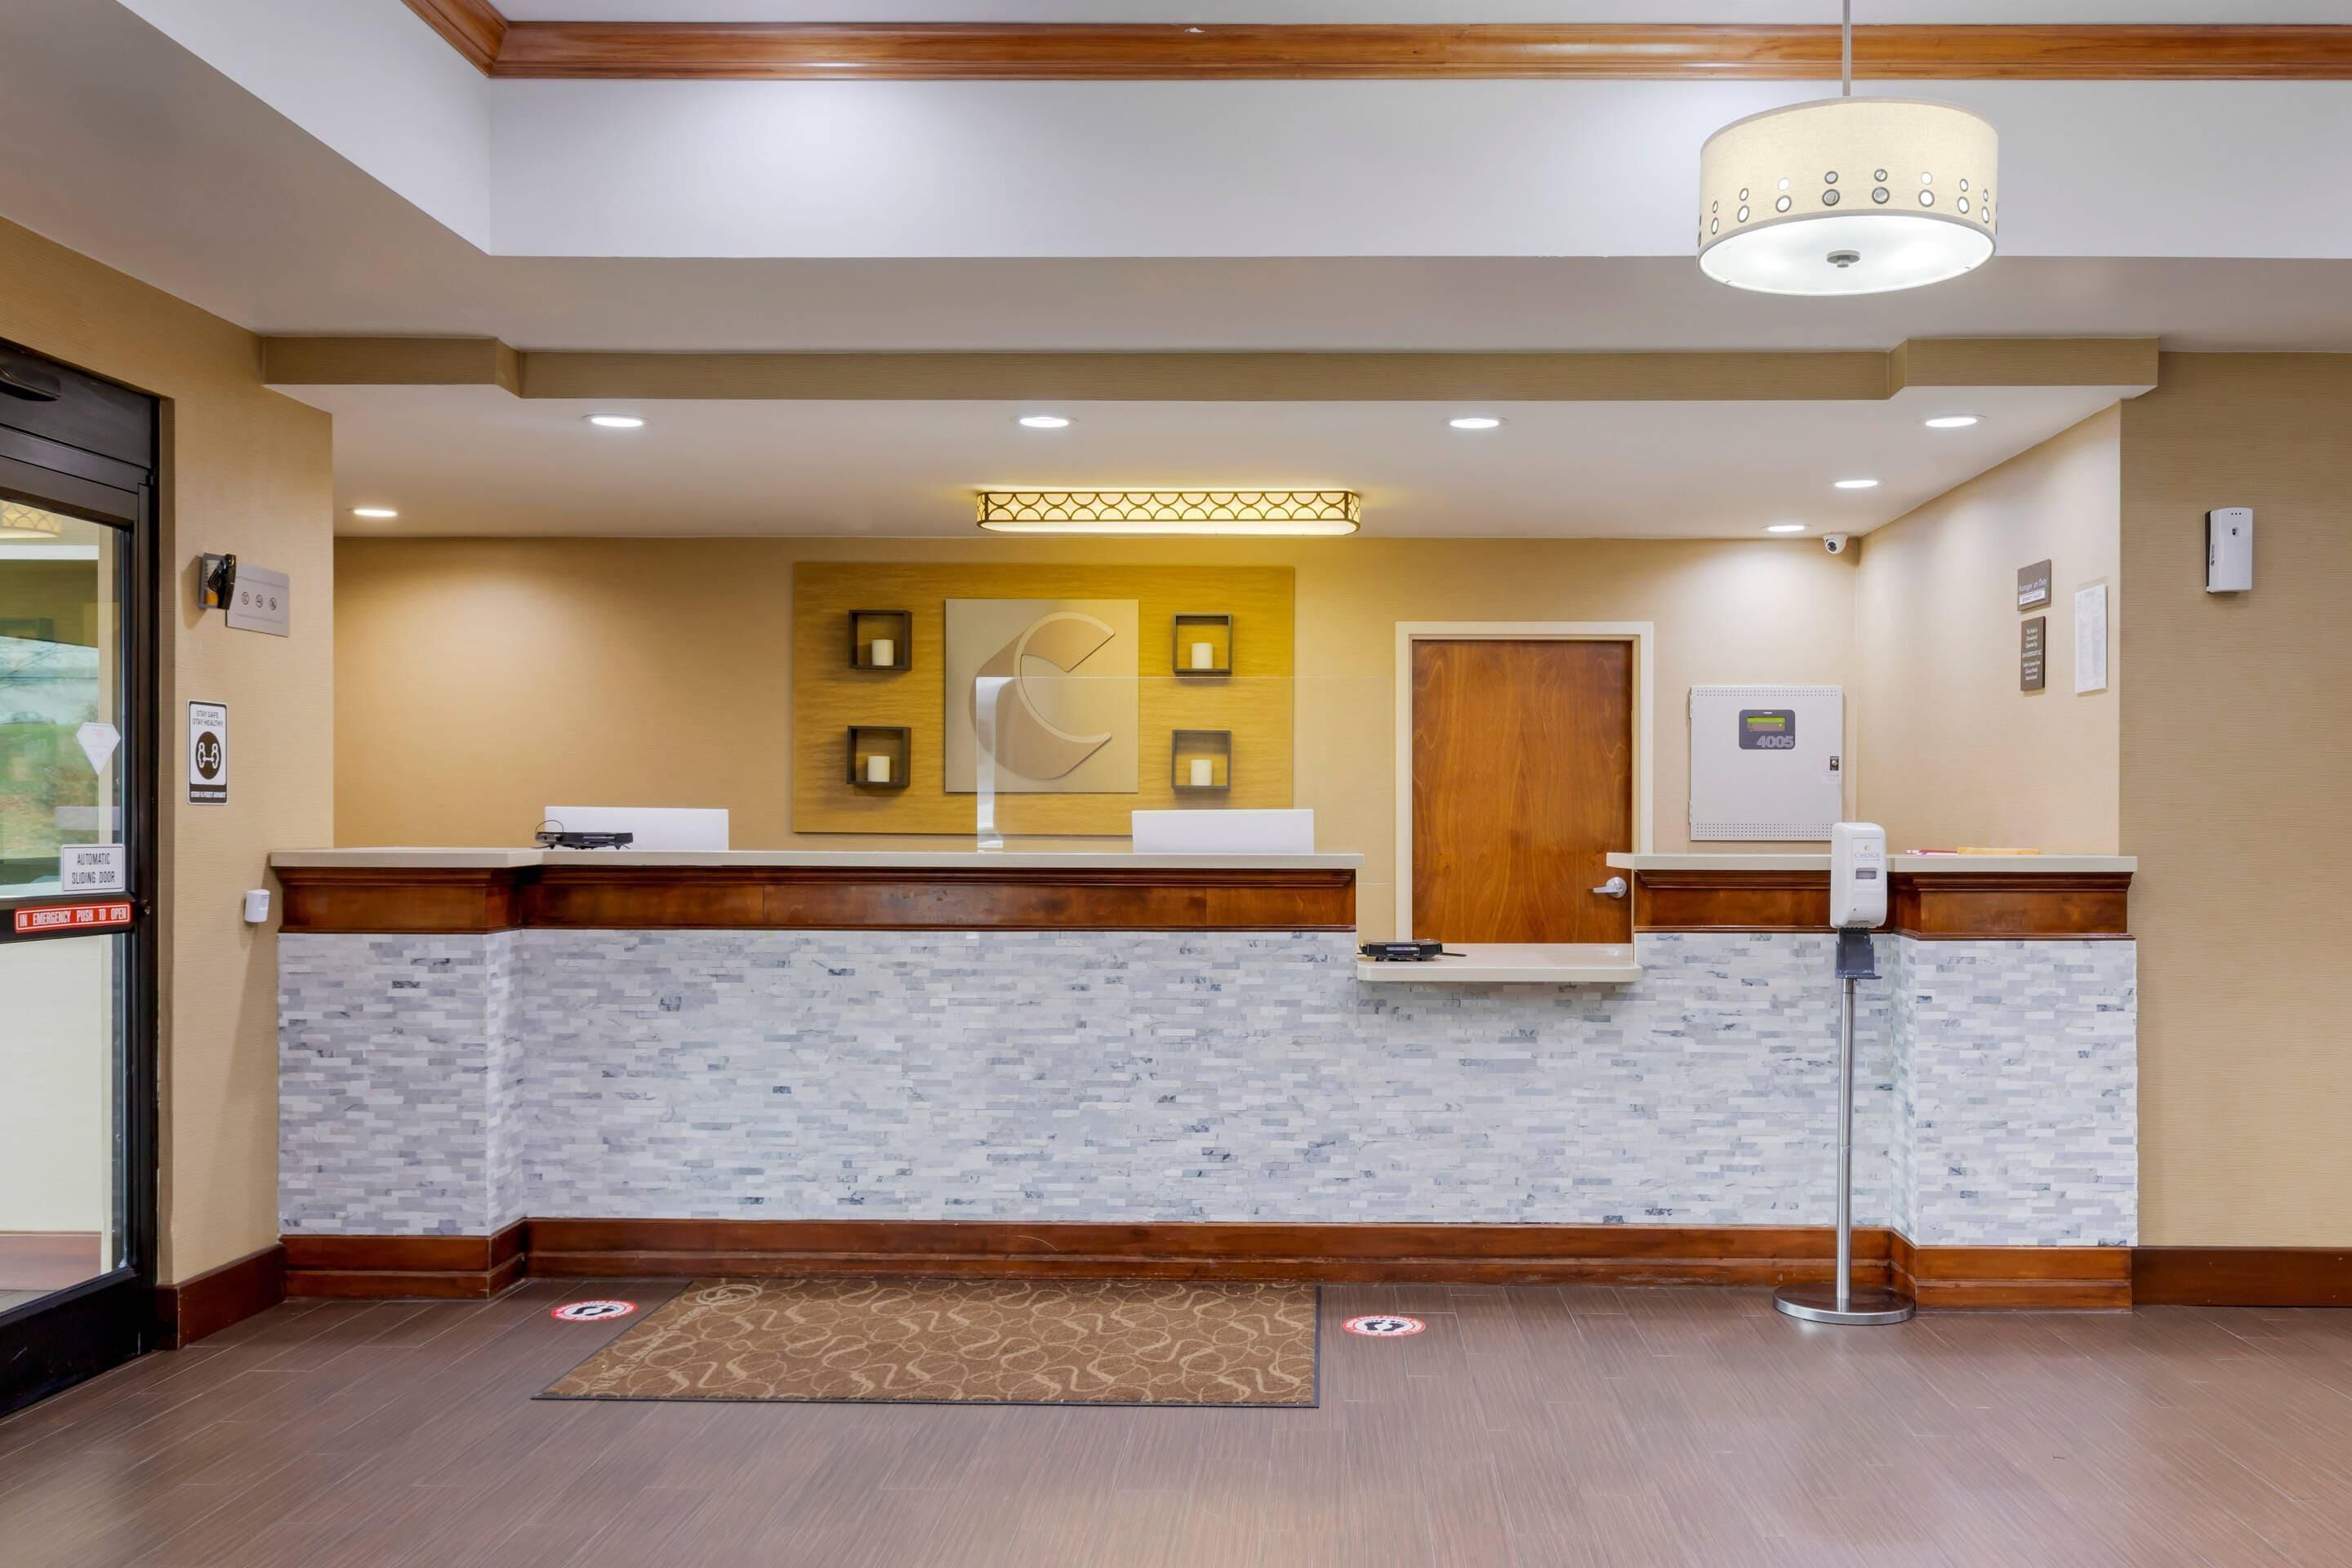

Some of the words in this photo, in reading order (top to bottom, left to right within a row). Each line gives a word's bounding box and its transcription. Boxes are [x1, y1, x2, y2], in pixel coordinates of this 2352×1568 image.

[1757, 735, 1794, 748] 4005
[78, 853, 110, 865] AUTOMATIC
[72, 871, 96, 884] SLIDING
[99, 871, 115, 883] DOOR
[20, 914, 28, 927] IN
[33, 911, 71, 925] EMERGENCY
[77, 909, 93, 922] PUSH
[98, 908, 106, 920] TO
[111, 907, 127, 920] OPEN
